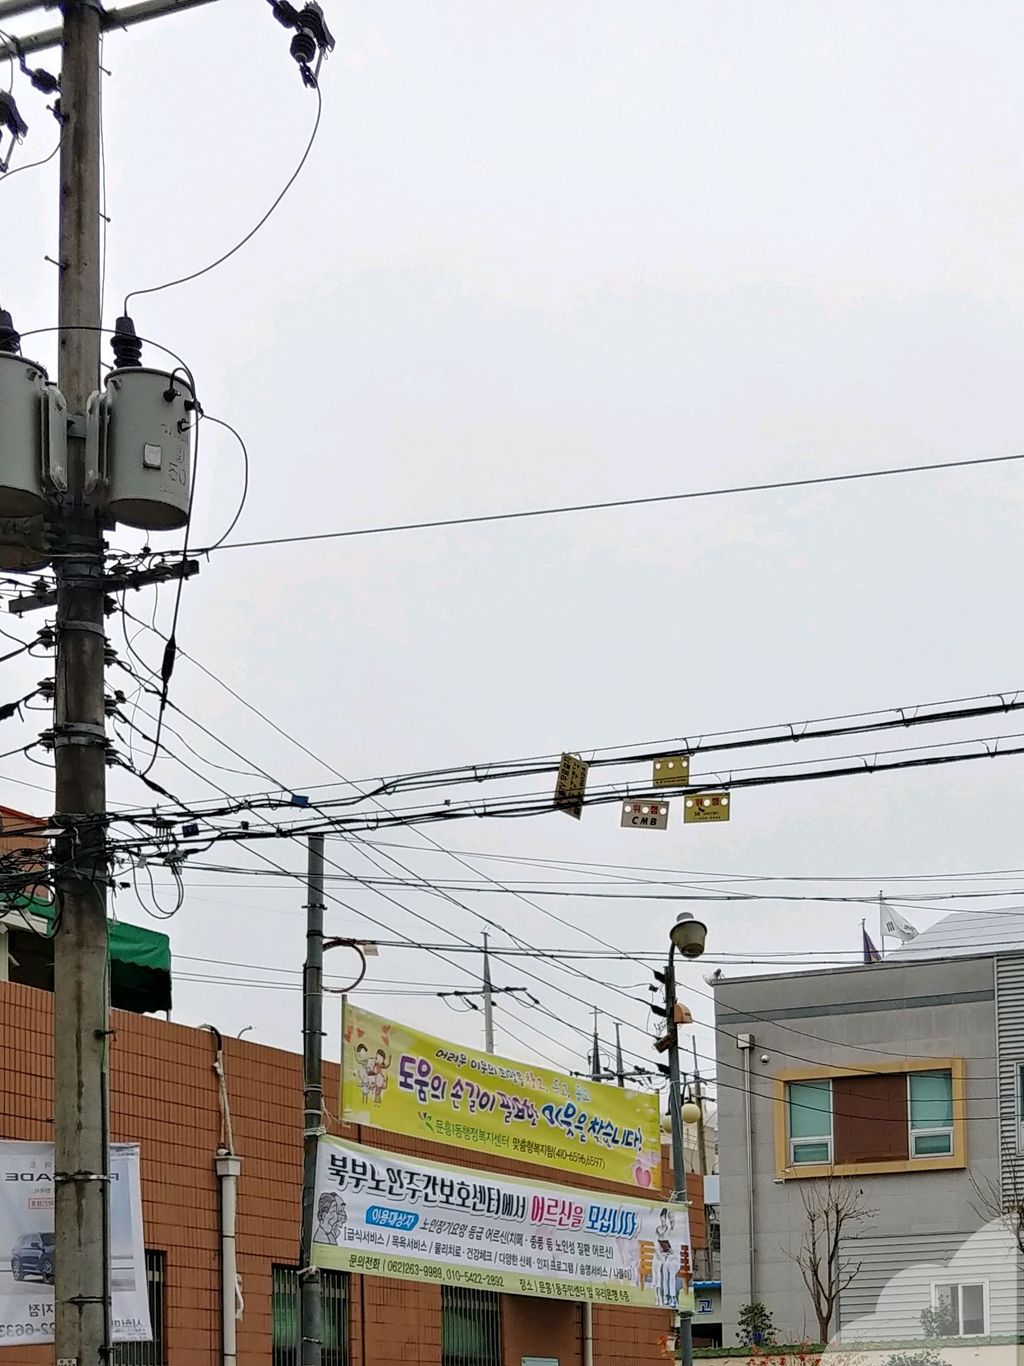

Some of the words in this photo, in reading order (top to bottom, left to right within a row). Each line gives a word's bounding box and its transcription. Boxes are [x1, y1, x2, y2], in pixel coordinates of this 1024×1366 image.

[631, 816, 658, 826] CMB
[436, 1049, 467, 1067] 어려운
[399, 1055, 447, 1103] 도움의
[450, 1079, 497, 1113] 손길이
[328, 1154, 526, 1219] 북부노인주간보호센터에서
[531, 1194, 584, 1229] 어르신을
[586, 1204, 637, 1236] 모십니다
[371, 1208, 415, 1228] 이용대상자
[419, 1218, 469, 1239] 노인장기요양
[348, 1253, 381, 1270] 문의전화
